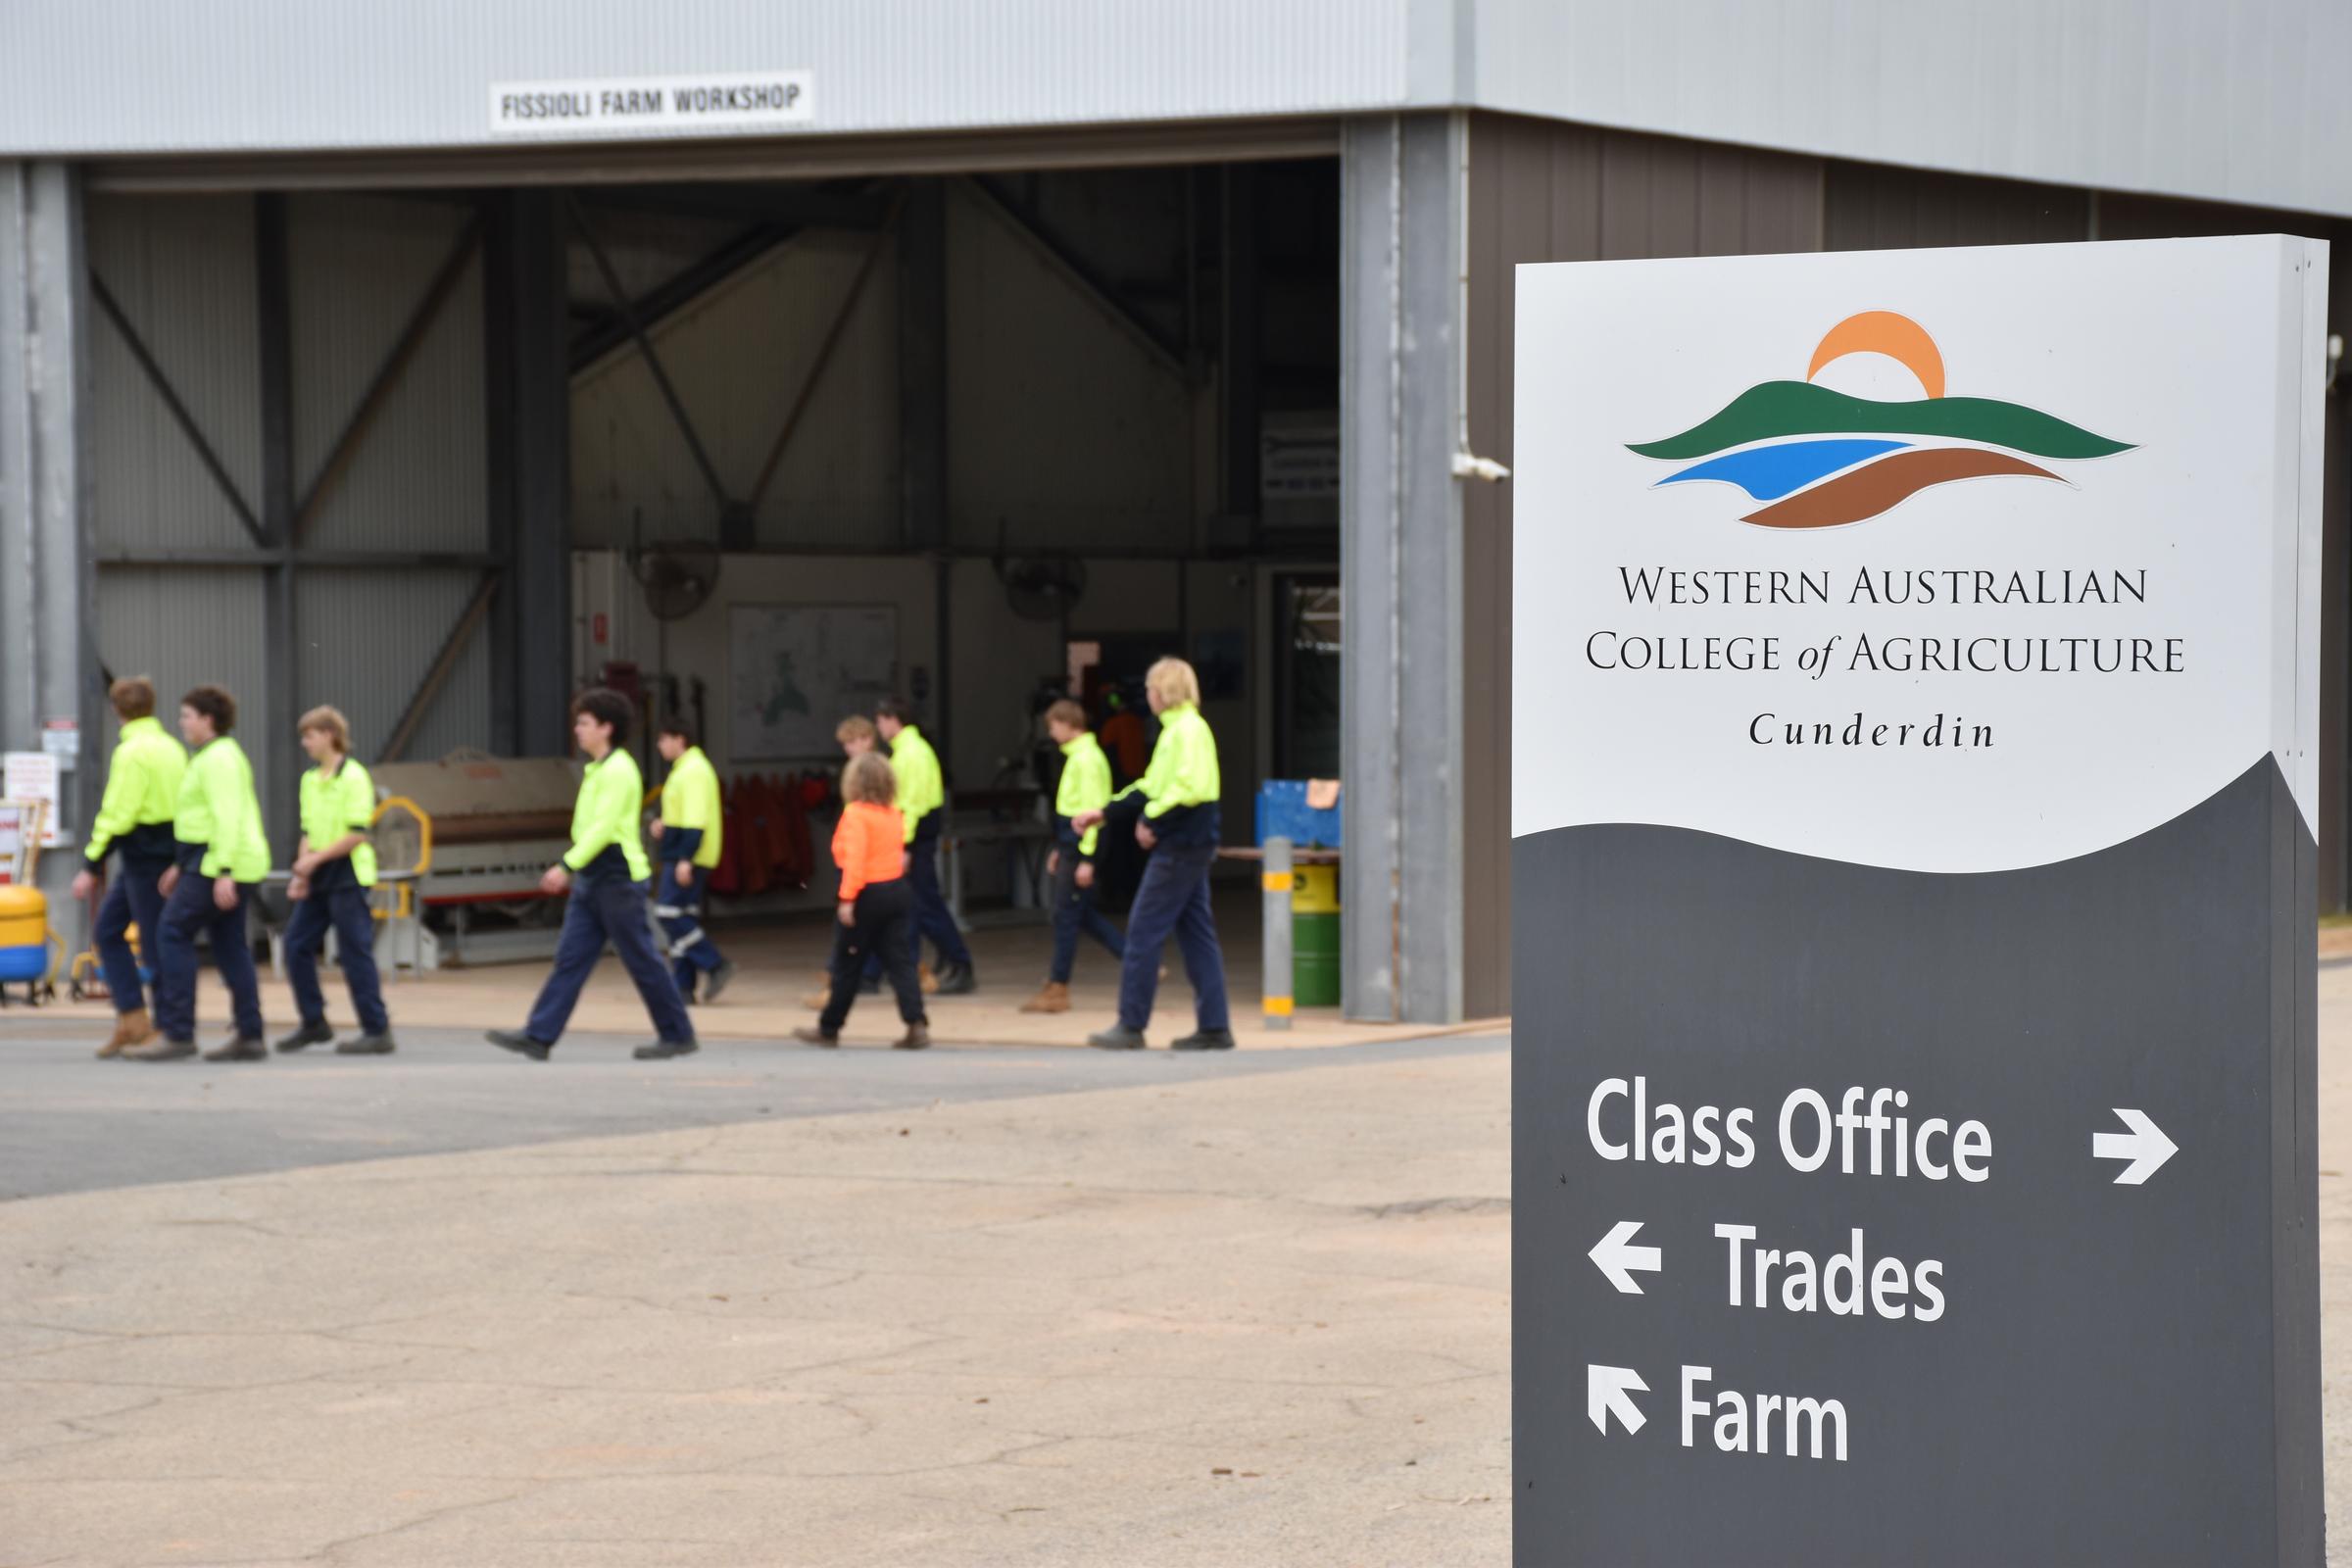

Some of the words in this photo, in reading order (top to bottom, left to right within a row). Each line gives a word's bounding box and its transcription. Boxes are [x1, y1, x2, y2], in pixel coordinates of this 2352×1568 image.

[502, 93, 590, 119] FISSIOLI
[600, 90, 663, 116] FARM
[674, 83, 801, 113] WORKSHOP
[1619, 566, 1830, 605] WESTERN
[1847, 565, 2146, 605] AUSTRALIAN
[1586, 630, 1781, 670] COLLEGE
[1797, 635, 1841, 681] of
[1847, 632, 2185, 673] AGRICULTURE
[1749, 711, 1995, 748] Cunderdin
[1587, 1075, 1756, 1169] Class
[1778, 1086, 1992, 1183] Office
[1714, 1222, 1946, 1322] Trades
[1681, 1364, 1848, 1462] Farm
